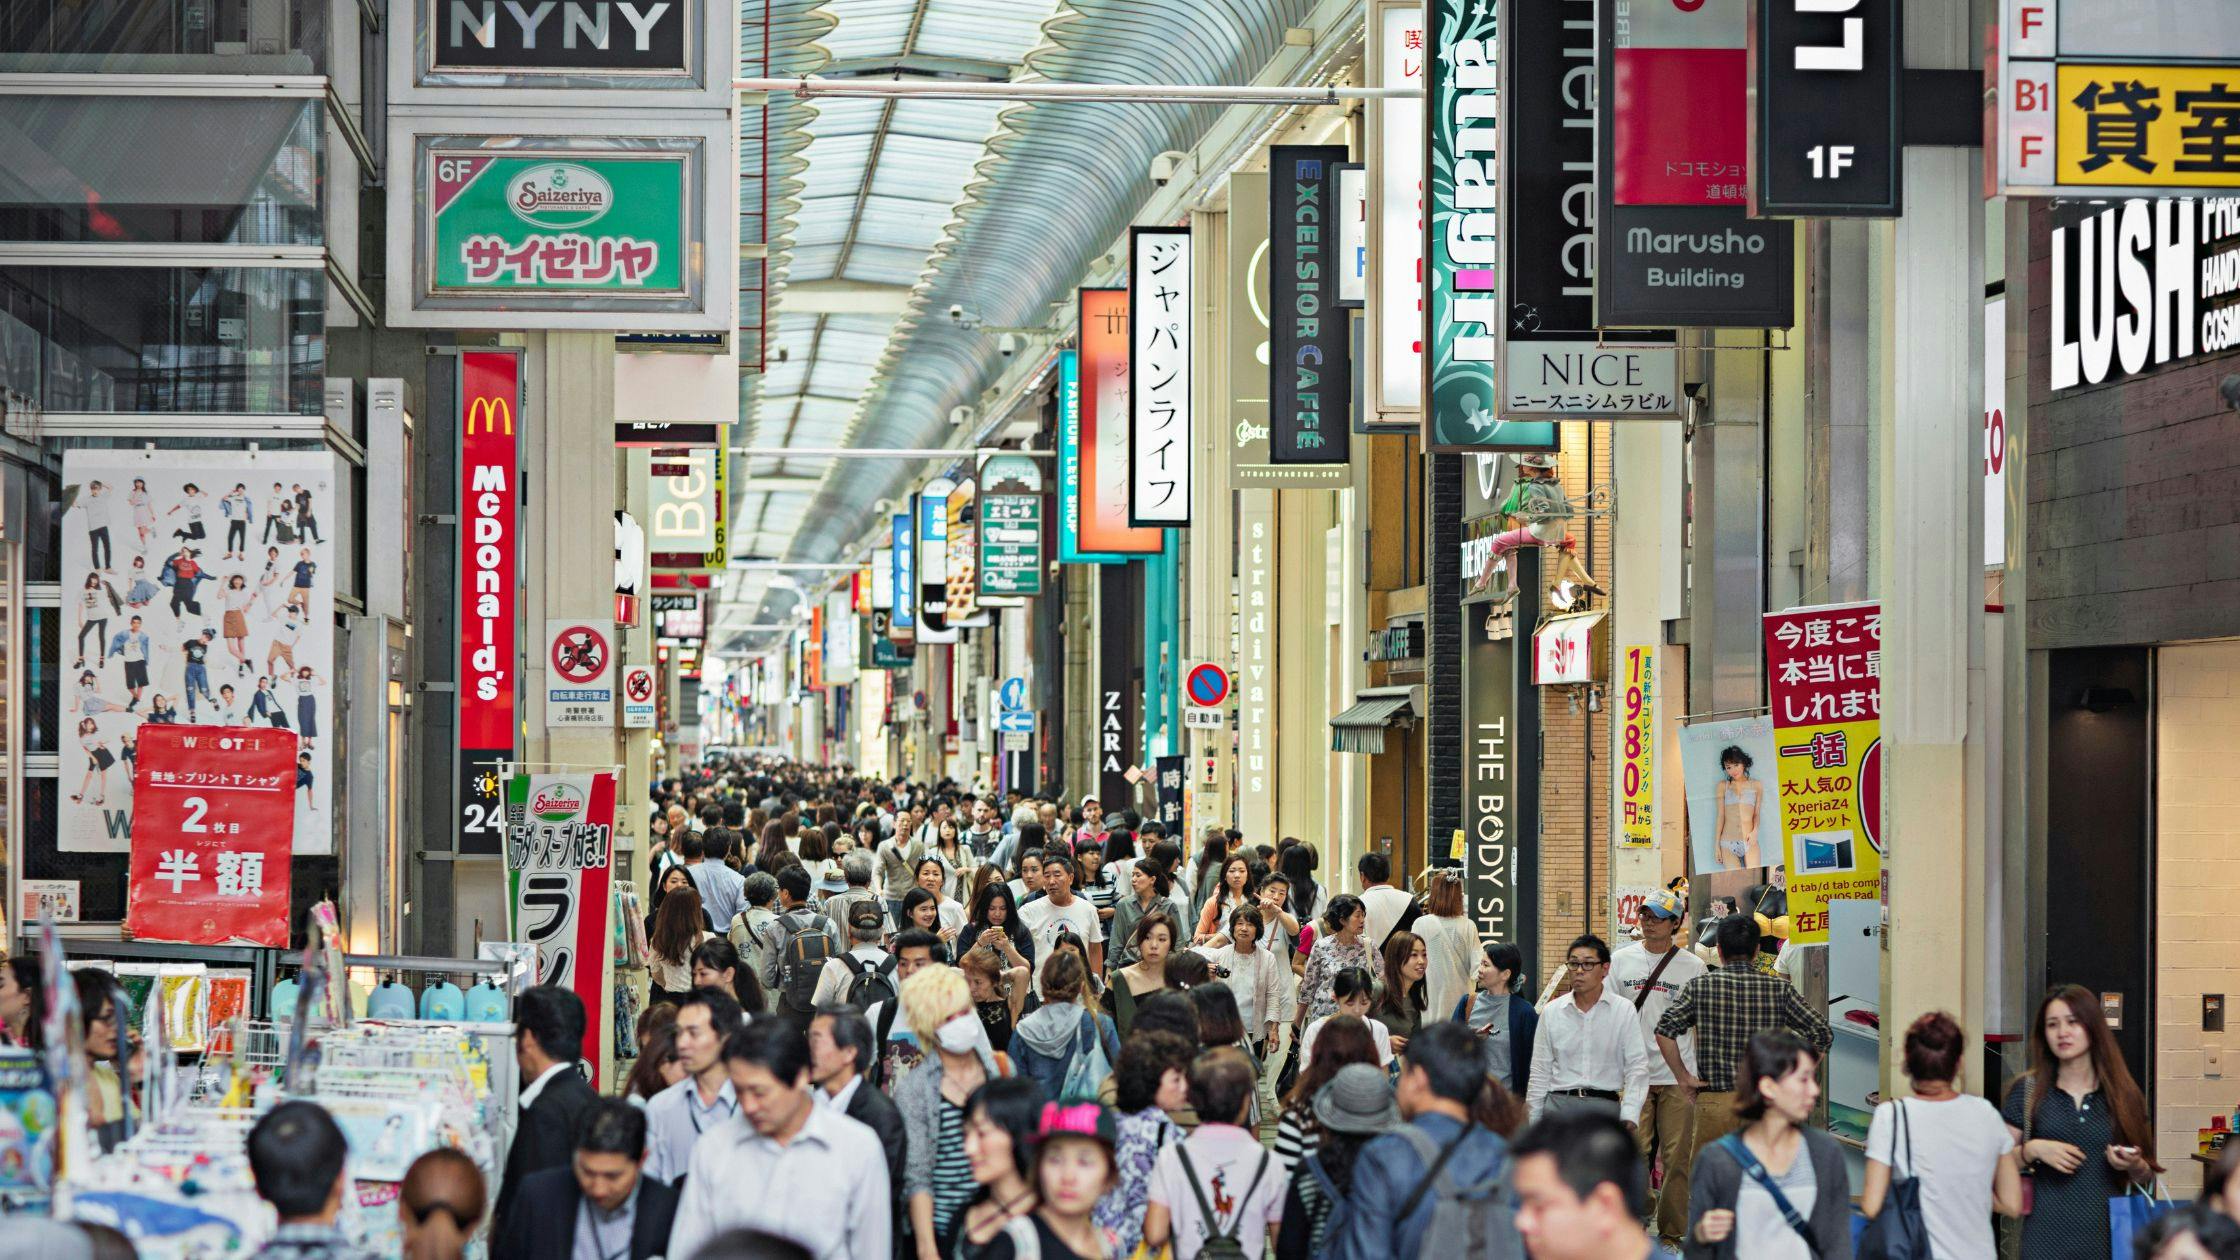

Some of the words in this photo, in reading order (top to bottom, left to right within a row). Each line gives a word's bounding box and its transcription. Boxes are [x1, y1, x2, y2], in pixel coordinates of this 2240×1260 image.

[450, 1, 671, 50] NYNY
[2016, 79, 2049, 111] B1
[2072, 79, 2240, 174] 貸室
[1807, 146, 1854, 178] 1F
[2020, 136, 2043, 168] F
[438, 161, 472, 183] 6F
[517, 181, 602, 211] Saizeriya
[1296, 160, 1322, 338] EXCELSIOR
[1628, 228, 1765, 254] Marusho
[463, 236, 656, 283] サイゼリヤ
[2202, 249, 2240, 299] HAND
[1648, 267, 1745, 289] Building
[2051, 198, 2195, 391] LUSH
[1543, 353, 1643, 387] NICE
[1296, 345, 1325, 449] CAFFÉ
[1512, 394, 1672, 411] ニースニシムラビル
[472, 465, 506, 702] McDonald's
[1249, 521, 1265, 793] stradivarius
[1103, 691, 1122, 772] ZARA
[1187, 712, 1222, 724] 自動車
[1478, 716, 1504, 780] THE
[1780, 731, 1848, 769] 一括
[534, 794, 580, 813] Saizeriya
[1162, 769, 1182, 822] 時計
[1782, 776, 1852, 797] 大人気の
[1787, 801, 1849, 816] XperiaZ4
[1788, 814, 1851, 831] タブレット
[1478, 798, 1504, 888] BODY
[154, 848, 265, 898] 半額
[1791, 883, 1798, 893] d
[1832, 880, 1850, 890] tab
[1852, 879, 1880, 889] comp
[1854, 890, 1874, 900] Pad
[1478, 897, 1504, 946] SH
